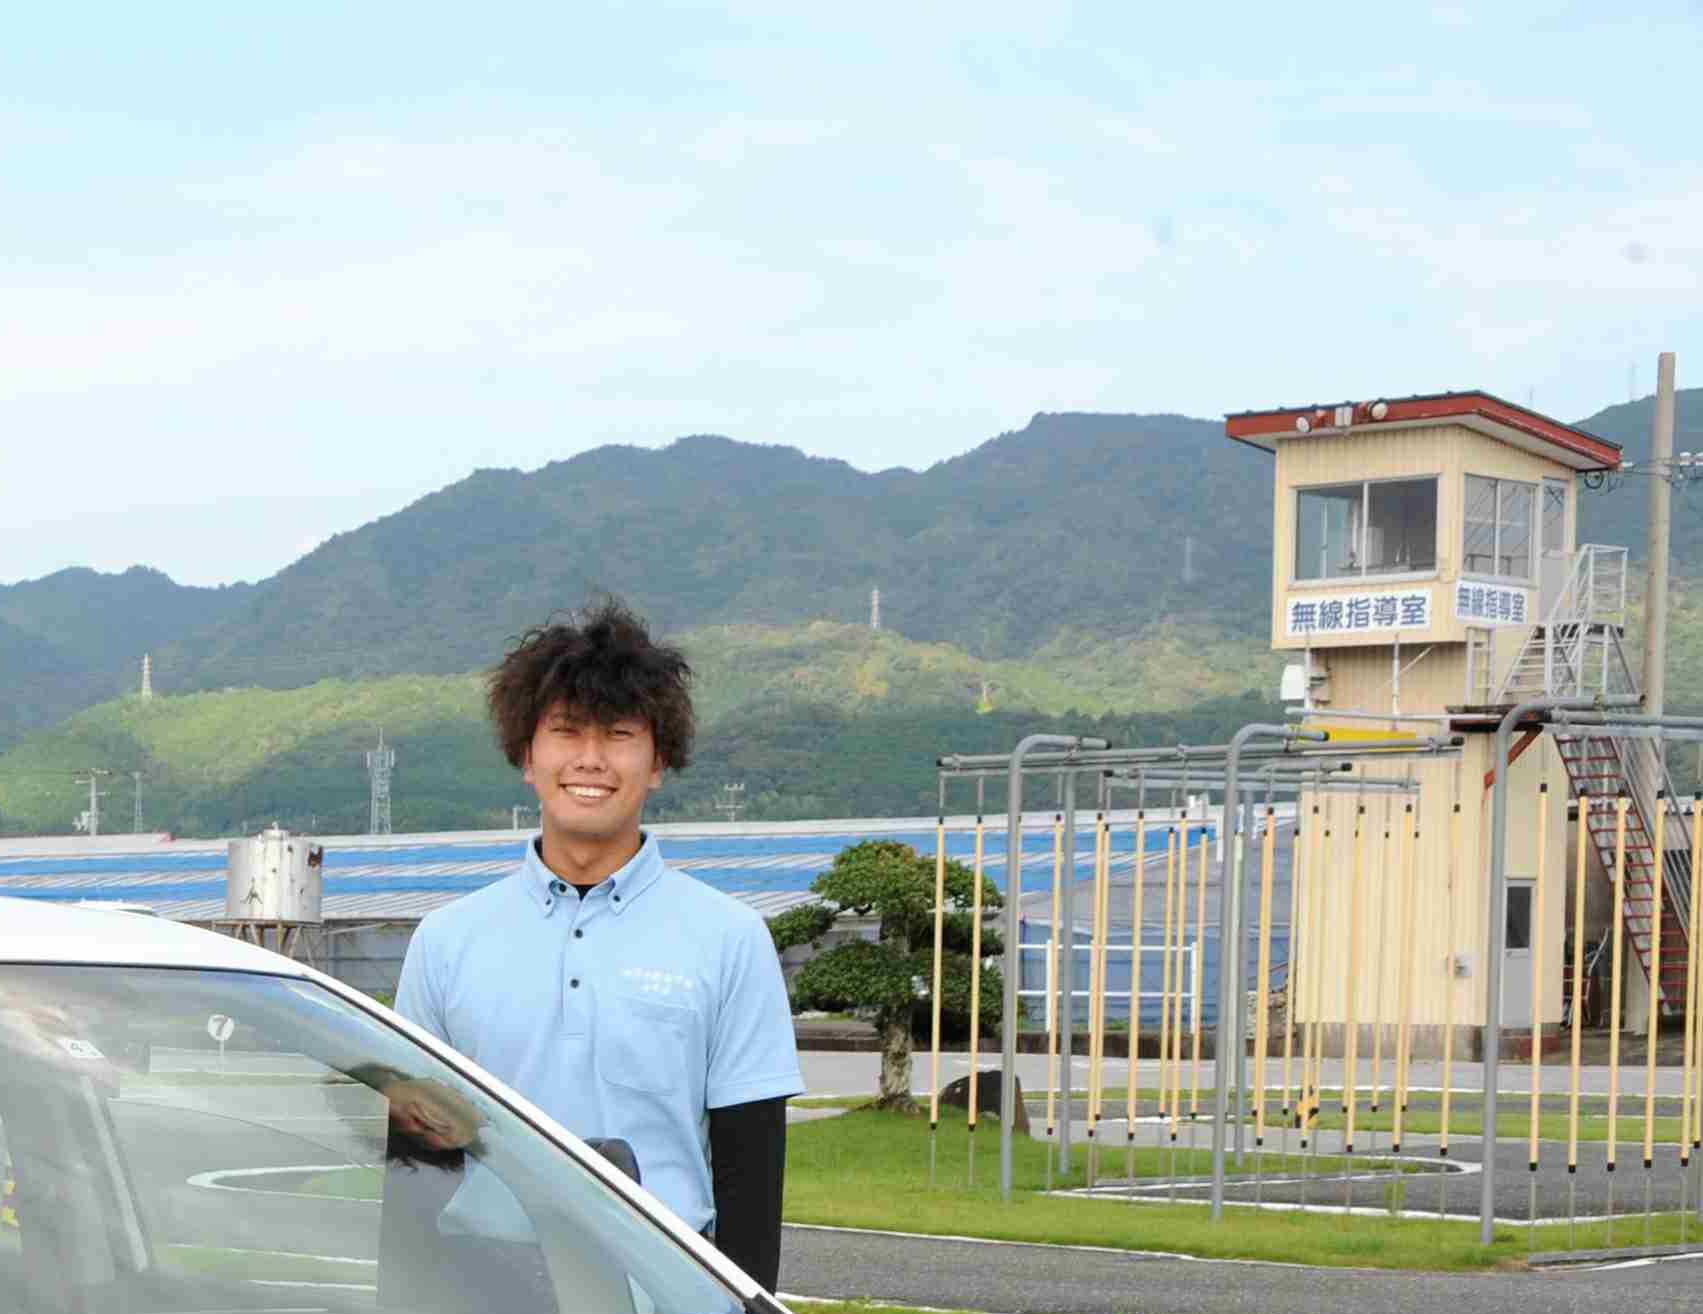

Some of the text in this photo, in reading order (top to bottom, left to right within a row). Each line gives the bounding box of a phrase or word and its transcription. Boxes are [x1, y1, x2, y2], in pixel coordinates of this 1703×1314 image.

[1291, 594, 1427, 632] 無線指導室
[1457, 586, 1525, 622] 無線指導室
[211, 1015, 229, 1037] 7
